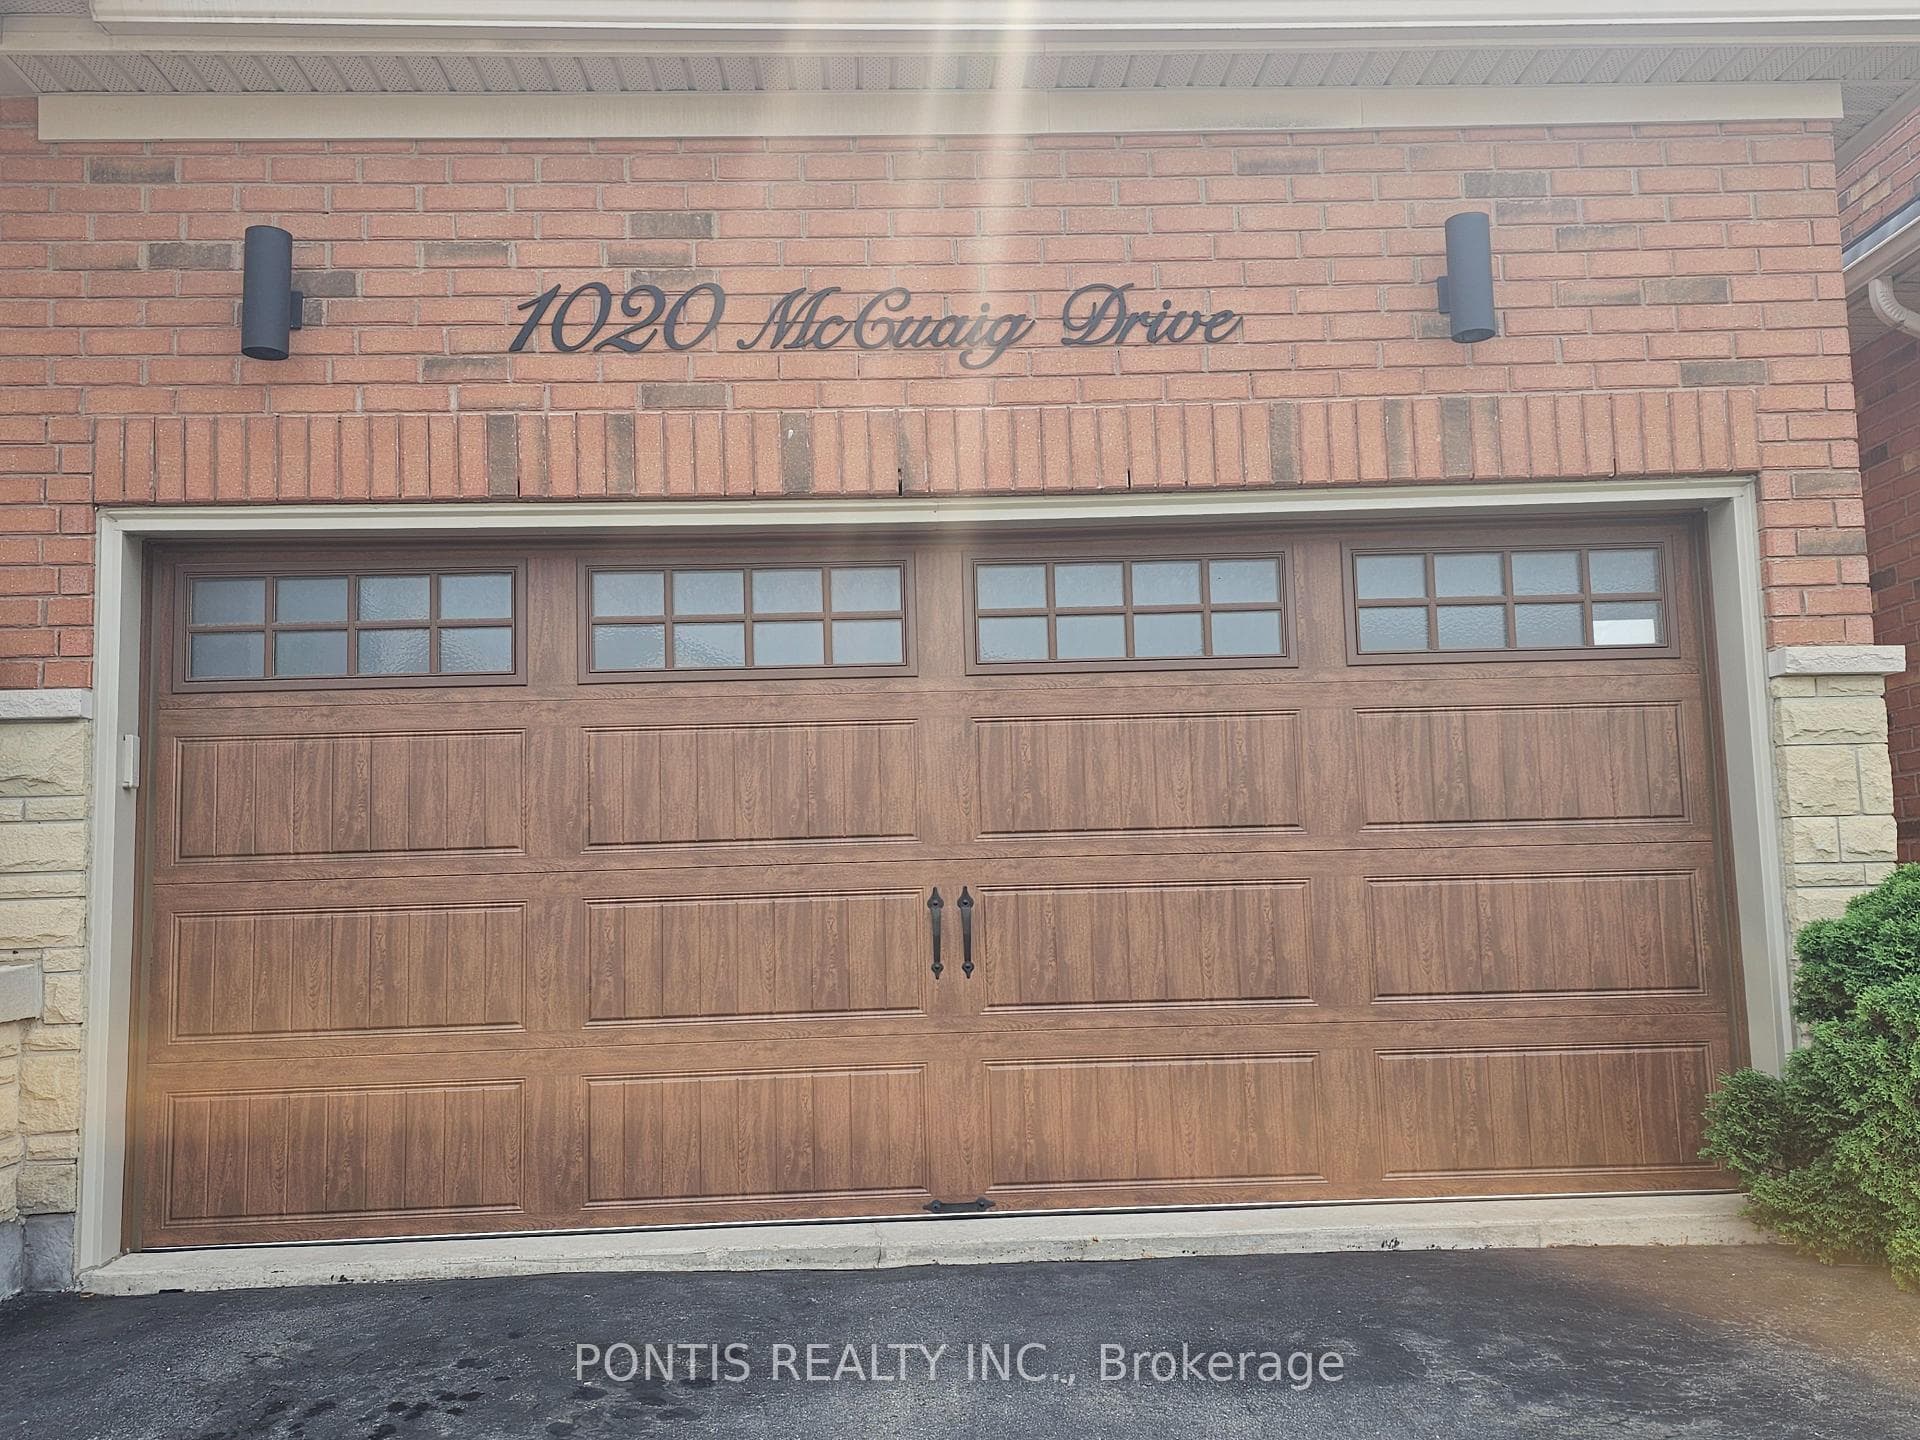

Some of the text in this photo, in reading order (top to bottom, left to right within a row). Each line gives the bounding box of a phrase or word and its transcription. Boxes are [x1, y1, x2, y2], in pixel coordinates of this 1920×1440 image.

[508, 282, 1244, 370] 1020 McCuaig Drive
